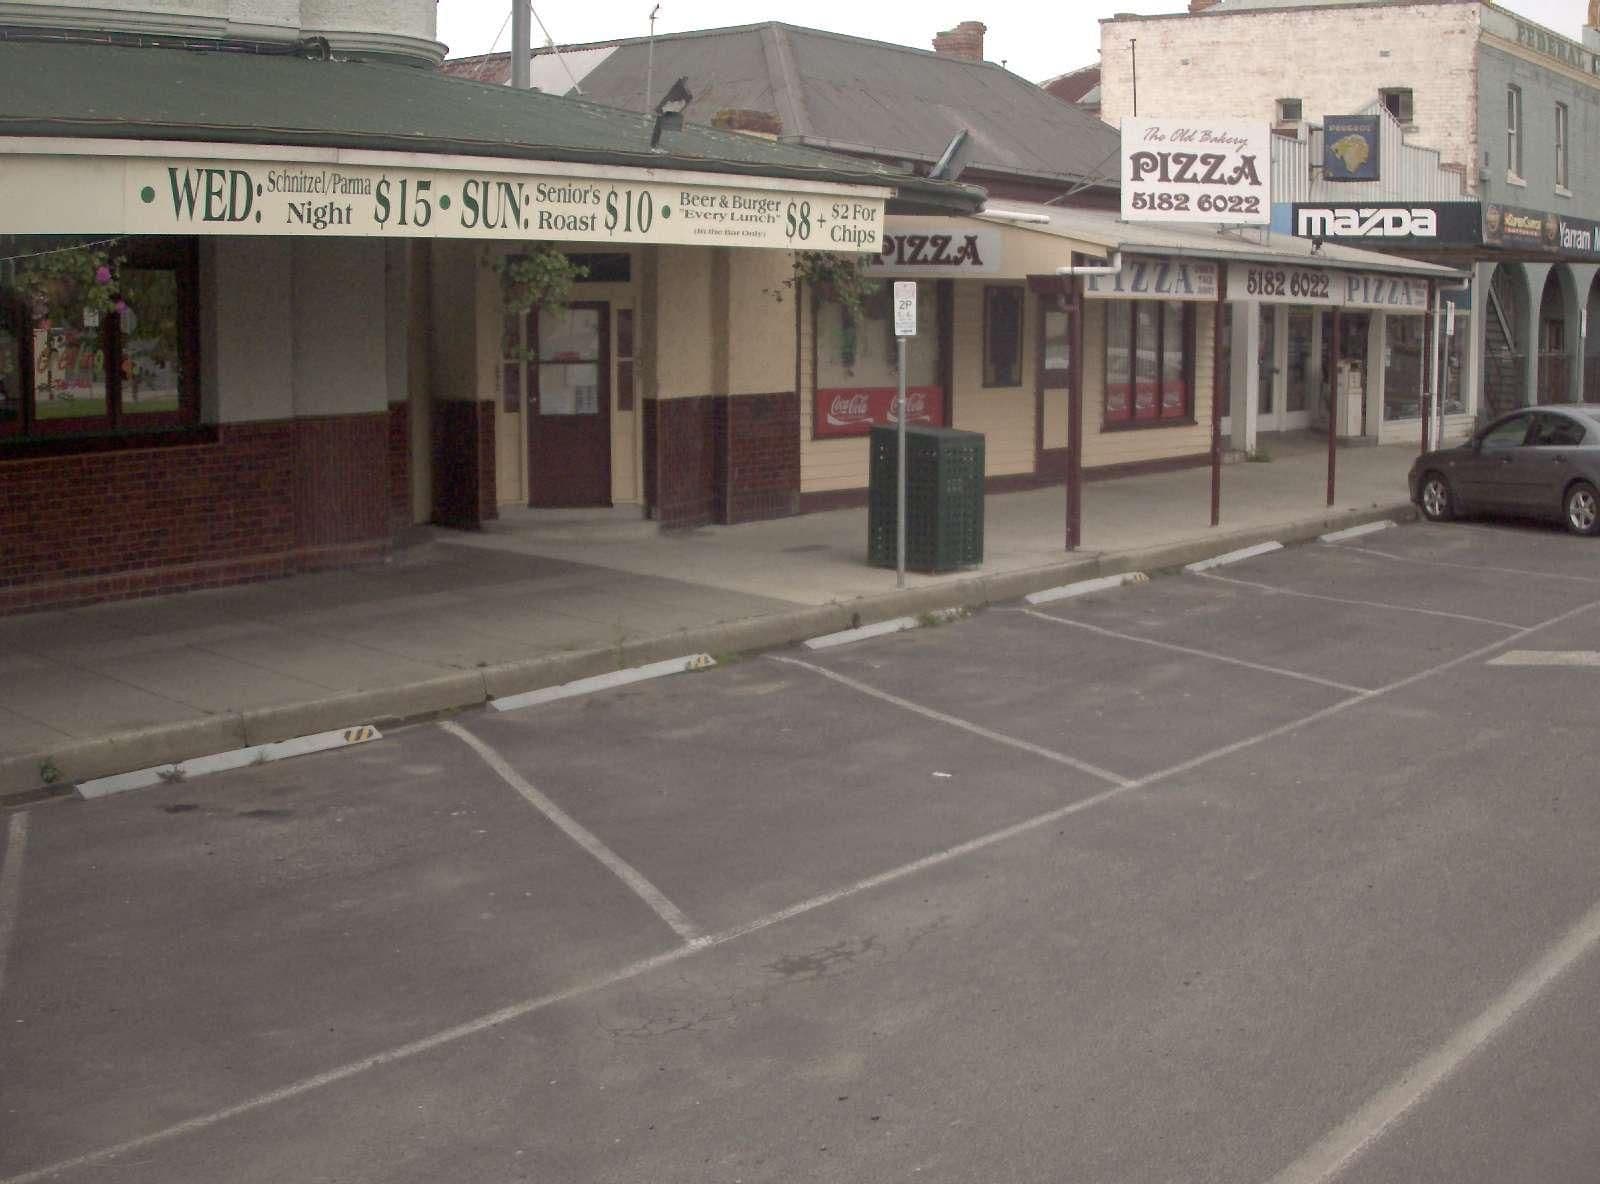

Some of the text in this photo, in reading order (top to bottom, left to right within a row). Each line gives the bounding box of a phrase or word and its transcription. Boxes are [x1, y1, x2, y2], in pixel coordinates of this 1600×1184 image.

[1144, 127, 1248, 152] The Old Bakery
[266, 169, 371, 195] Schnitzel/Parma
[1129, 151, 1262, 186] PIZZA
[168, 167, 263, 223] WED:
[374, 173, 432, 230] $15
[461, 179, 529, 230] SUN:
[535, 183, 601, 205] Senior's
[680, 191, 781, 214] Beer & Burger
[1131, 192, 1260, 214] 5182 6022
[286, 201, 352, 229] Night
[538, 210, 597, 231] Roast
[604, 184, 653, 236] $10
[785, 197, 811, 243] $8
[832, 203, 877, 222] $2 For
[830, 224, 875, 247] Chips
[1560, 221, 1591, 251] Yarram
[872, 234, 984, 266] PIZZA
[1247, 270, 1329, 298] 5182 6022
[1345, 274, 1412, 306] PIZZA
[899, 300, 912, 310] 2P
[830, 393, 870, 416] Coca-Cola
[889, 392, 927, 415] C-Cola
